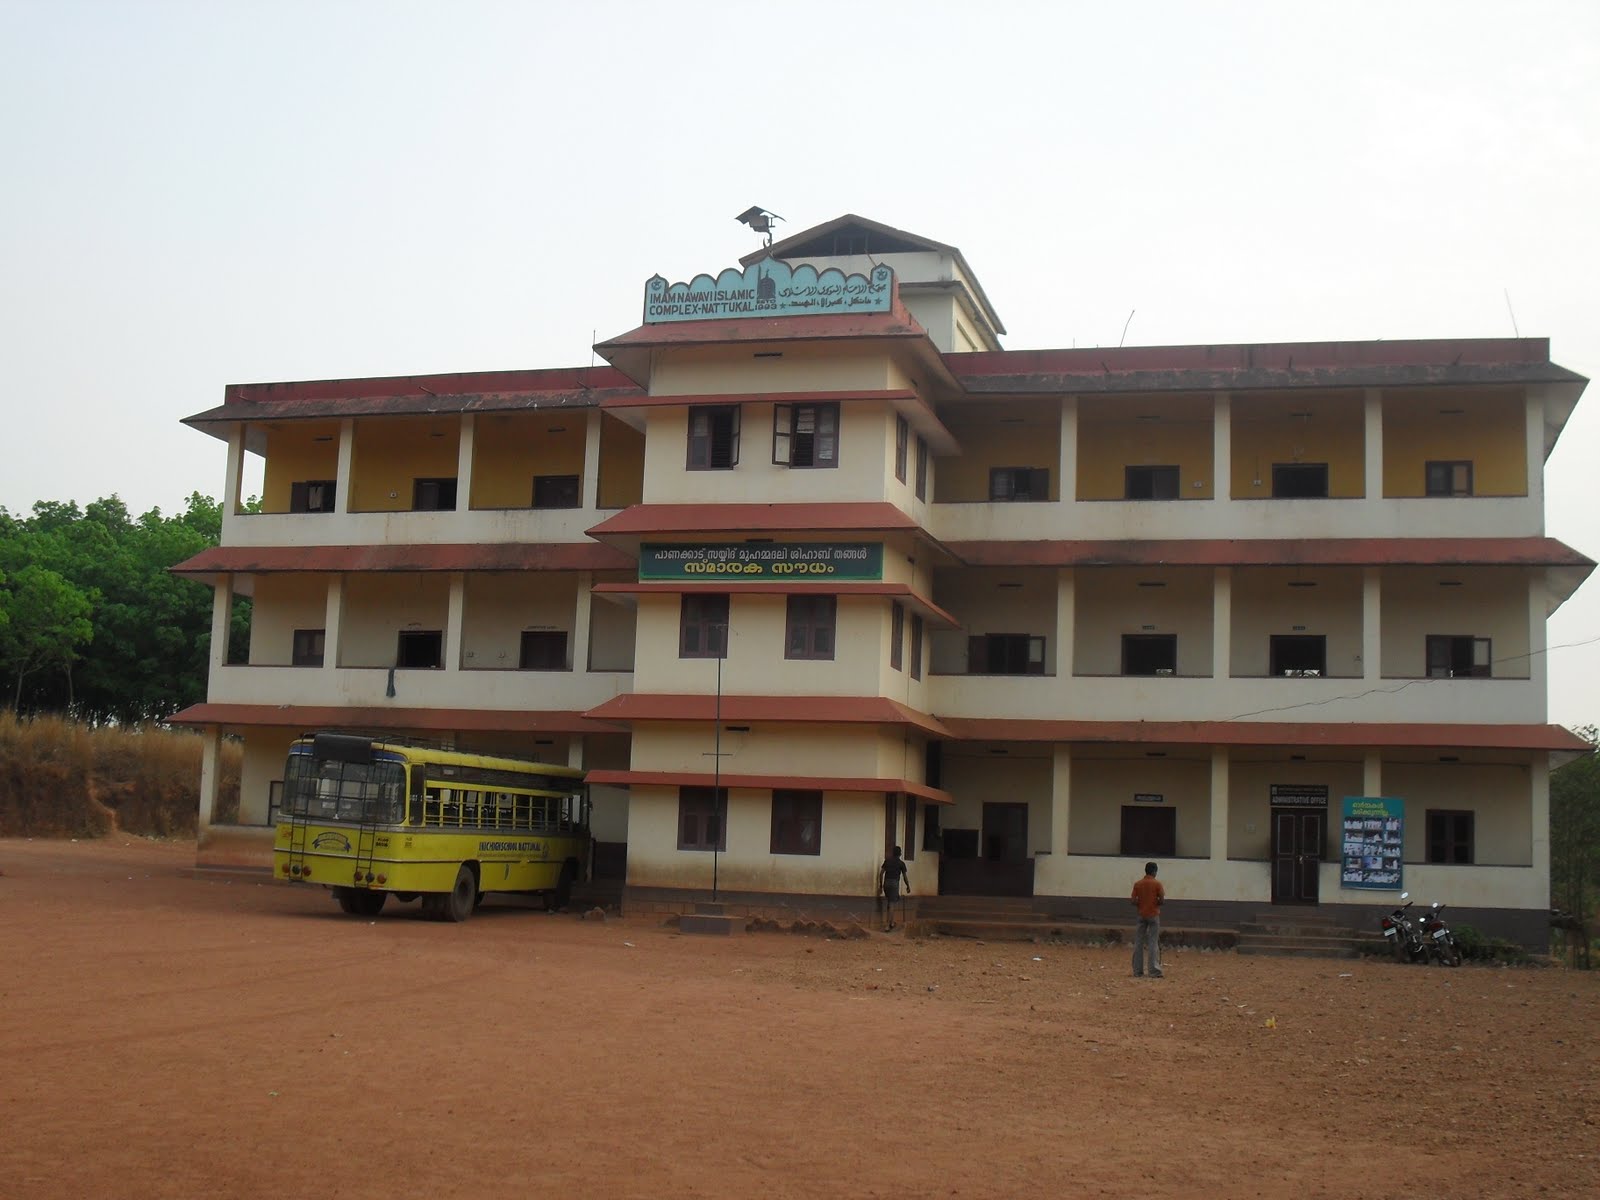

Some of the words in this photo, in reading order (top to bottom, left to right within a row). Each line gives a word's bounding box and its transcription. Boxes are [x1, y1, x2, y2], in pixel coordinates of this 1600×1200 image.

[650, 292, 676, 304] IMAM
[677, 290, 713, 303] NAWAVI
[714, 288, 755, 302] ISLAMIC
[649, 301, 755, 316] COMPLEX-NATTUKAL
[655, 547, 706, 560] പാണക്കാട്
[707, 547, 737, 562] സയ്യിദ്
[739, 547, 788, 562] മുഹമ്മദലി
[790, 547, 832, 560] ശിഹാബ്
[684, 558, 763, 574] സ്മാരക
[771, 561, 835, 575] സൗധം
[1272, 796, 1310, 804] ADMINISTRATIVE
[1310, 796, 1326, 805] OFFICE
